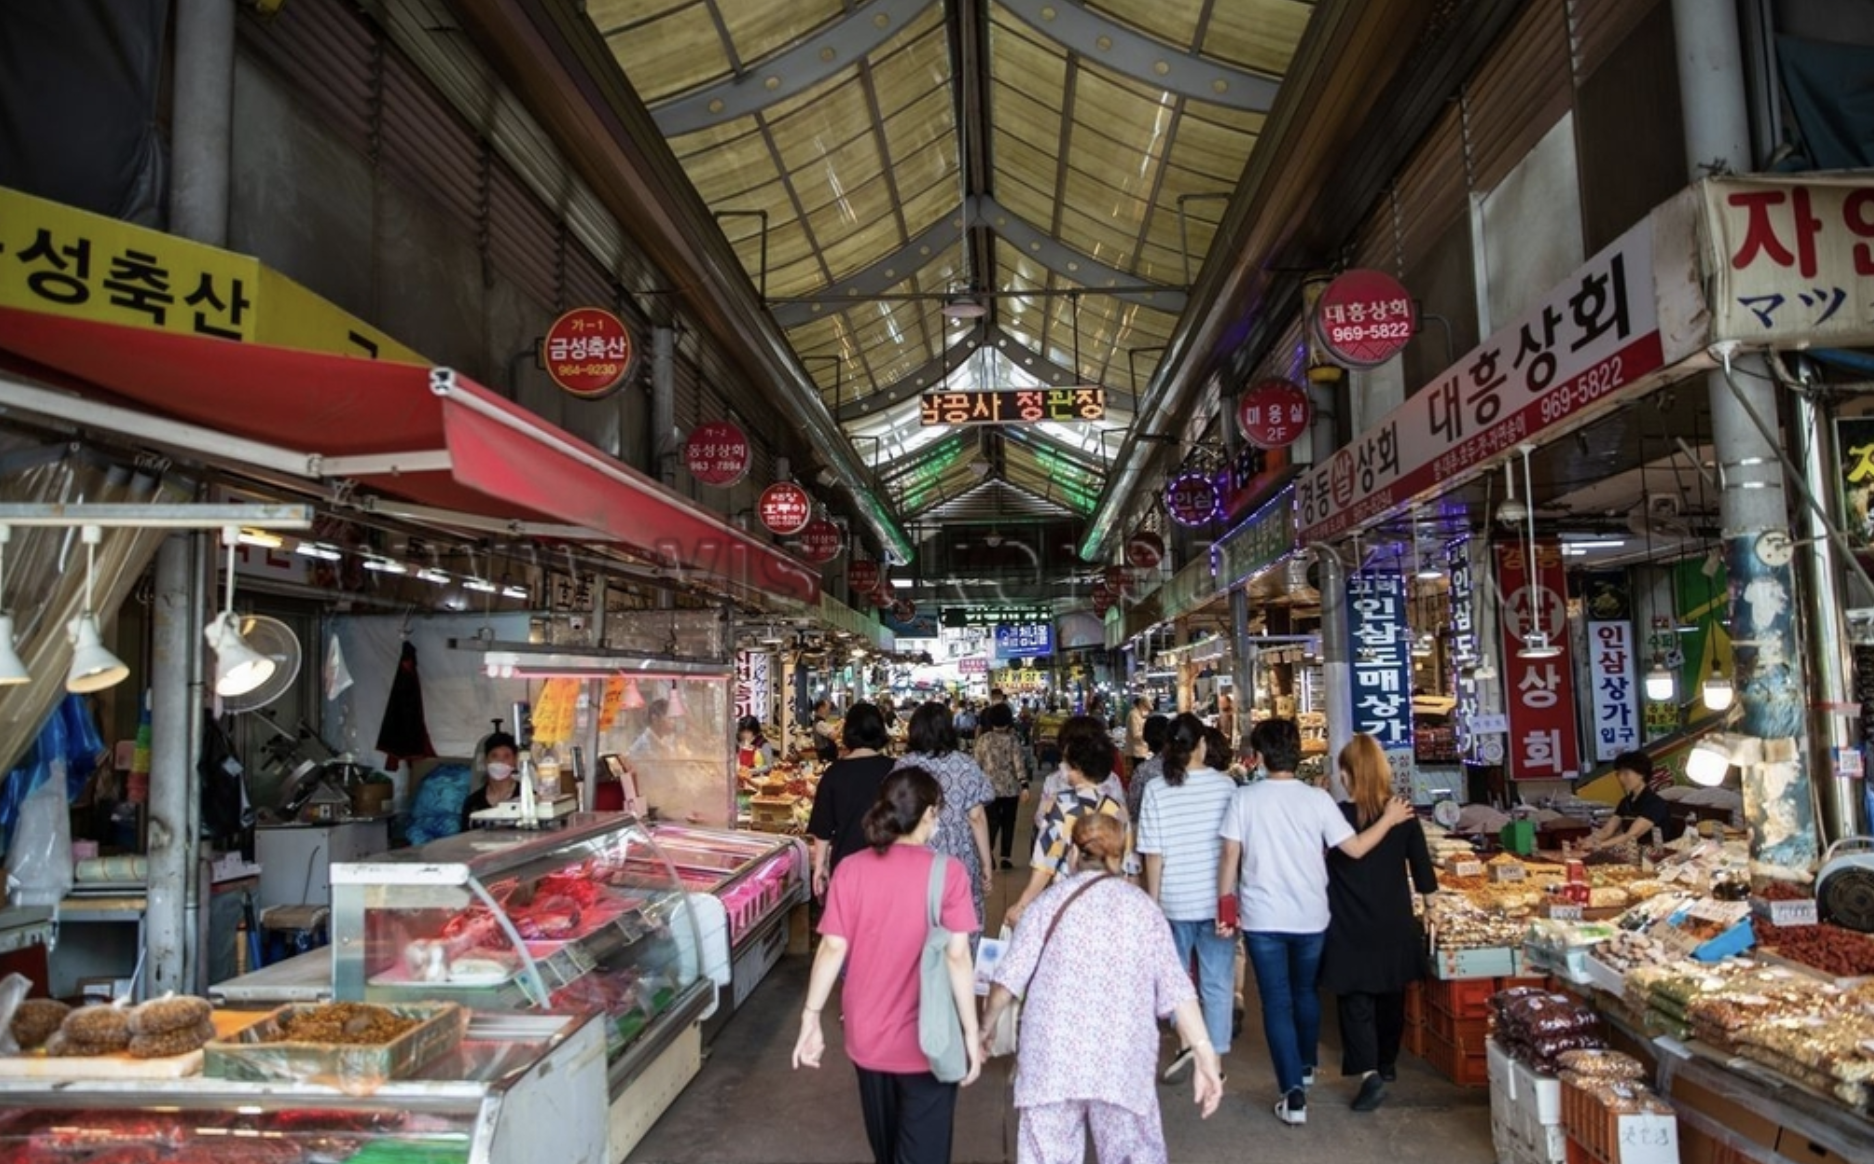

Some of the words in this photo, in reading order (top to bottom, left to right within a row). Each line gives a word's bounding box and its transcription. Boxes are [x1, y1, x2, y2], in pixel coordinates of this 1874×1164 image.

[0, 228, 250, 341] 성축산
[1325, 298, 1409, 324] 대흥상회
[1737, 286, 1874, 329] マツ
[549, 335, 627, 360] 금성축산
[1332, 321, 1409, 342] 969-5822
[1428, 251, 1630, 443] 대흥상회
[1017, 389, 1103, 421] 정관장
[1540, 356, 1624, 423] 969-5822
[1267, 427, 1287, 441] 2F
